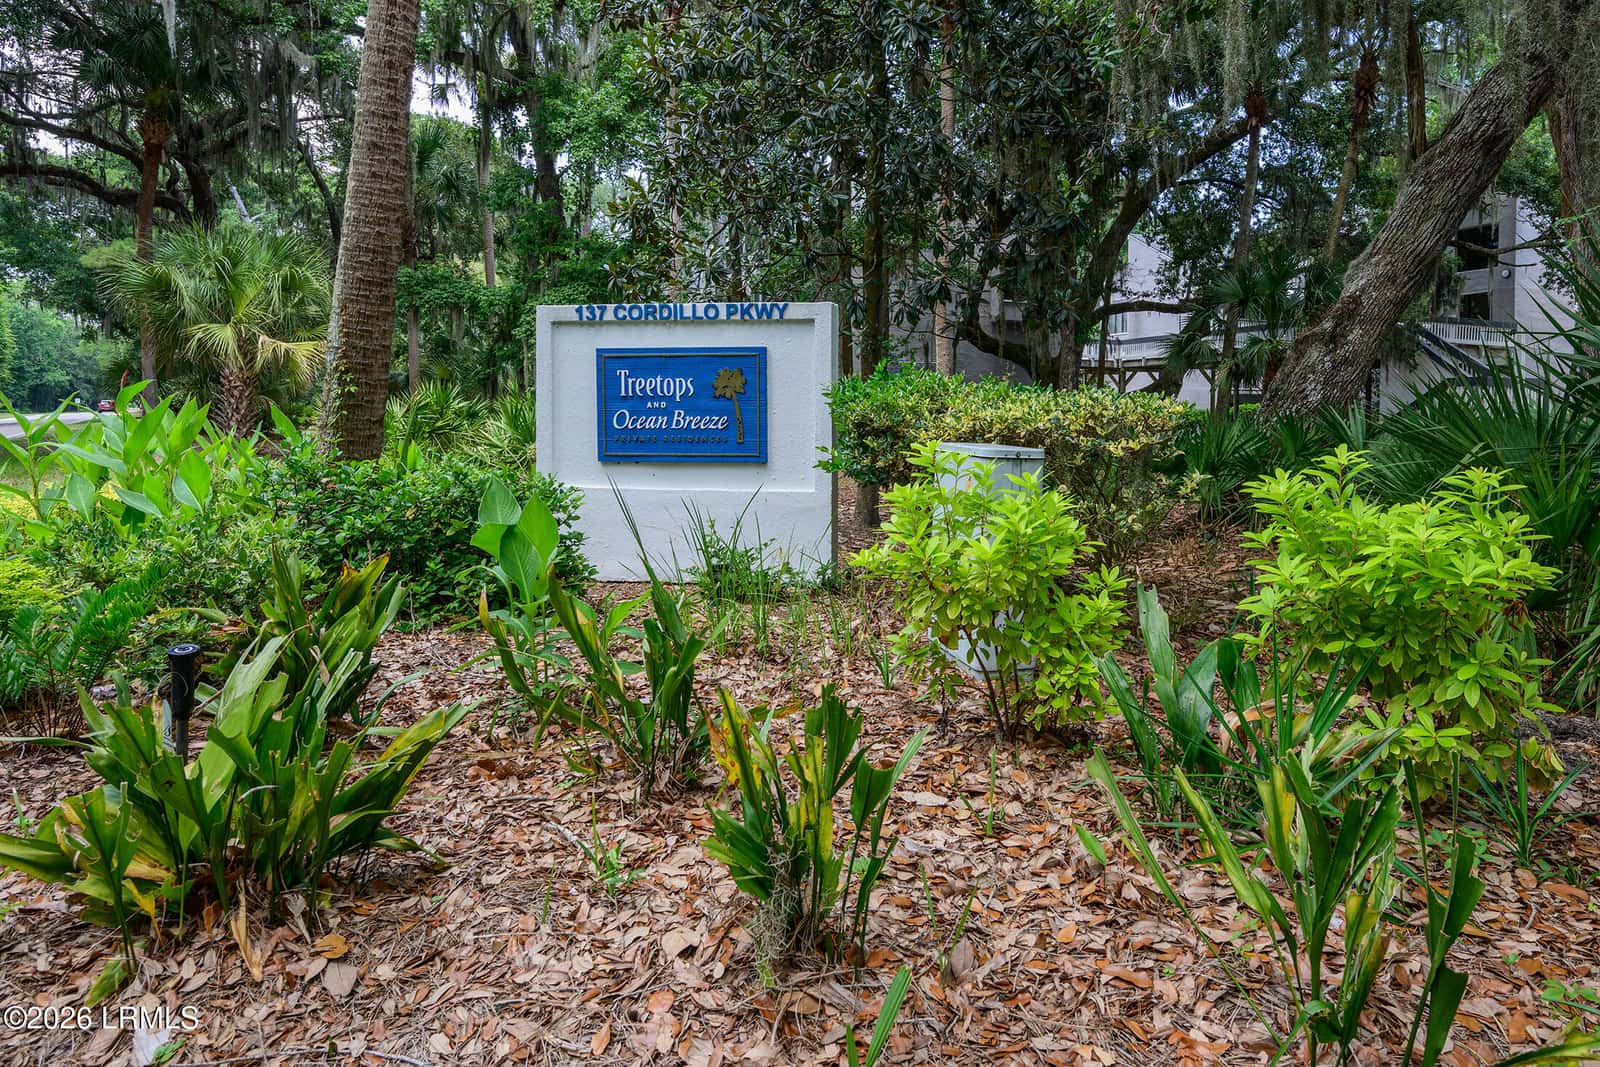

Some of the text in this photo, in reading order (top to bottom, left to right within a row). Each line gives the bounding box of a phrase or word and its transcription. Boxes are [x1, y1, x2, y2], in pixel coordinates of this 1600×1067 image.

[575, 303, 789, 321] 137 CORDILLO PKWY
[616, 369, 694, 402] Treetops
[647, 401, 667, 409] AND
[613, 409, 729, 430] Ocean Breeze
[613, 434, 657, 444] PRIVATE
